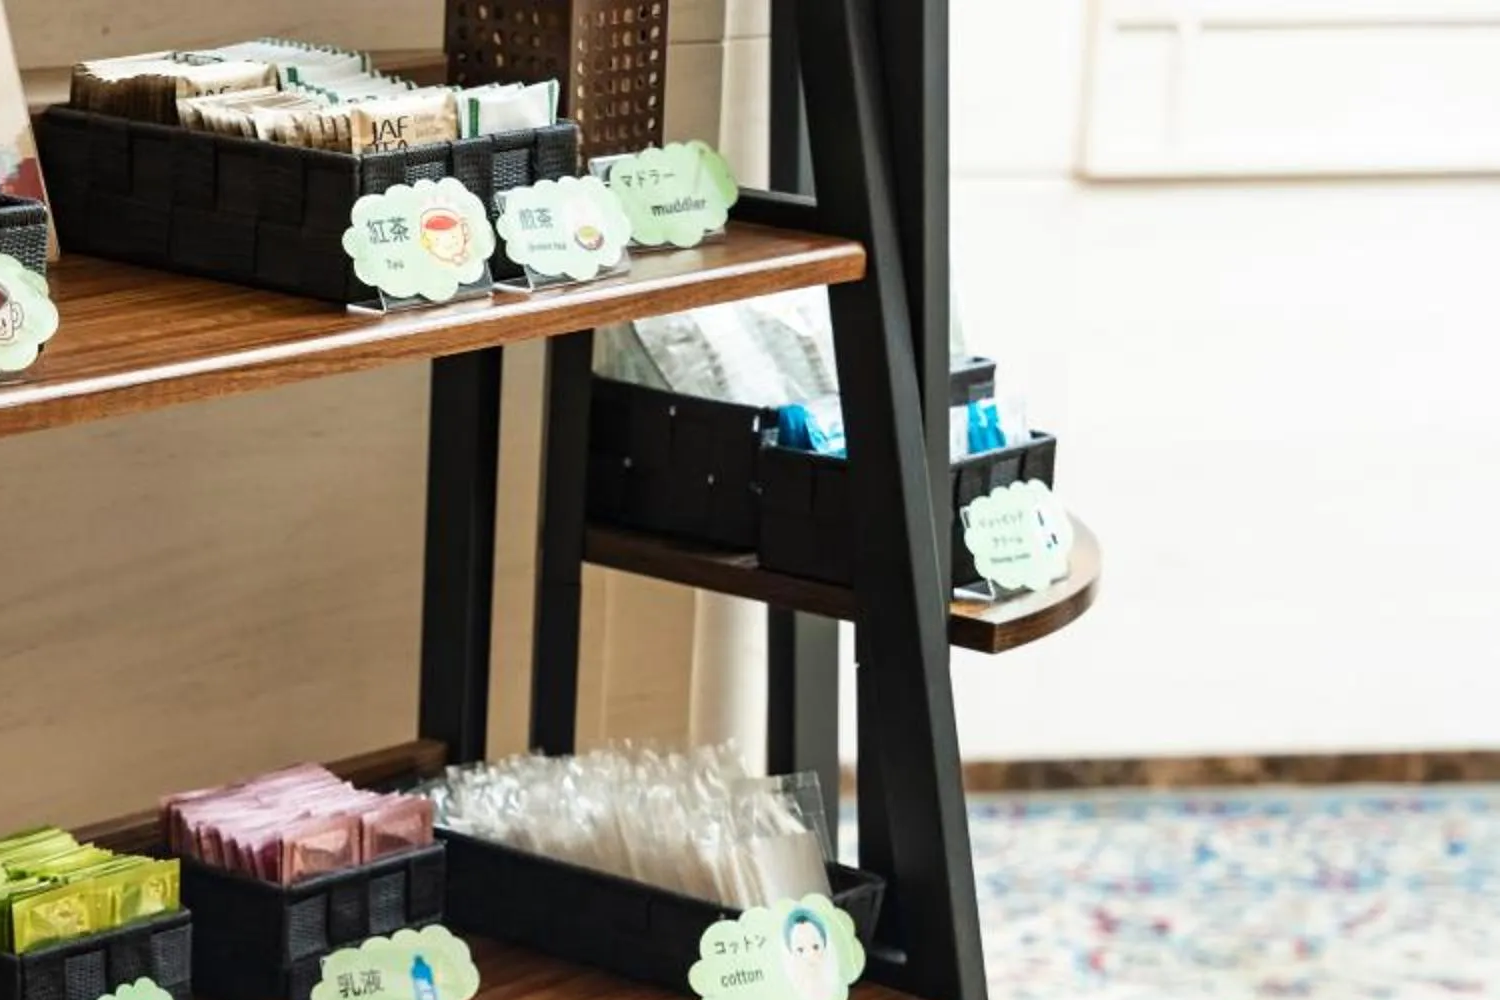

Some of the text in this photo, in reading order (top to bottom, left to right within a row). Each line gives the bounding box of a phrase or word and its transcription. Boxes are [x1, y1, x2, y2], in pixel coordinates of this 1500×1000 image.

[369, 115, 409, 142] JAF
[619, 168, 677, 188] マドラー
[649, 195, 707, 217] muddler
[366, 216, 411, 245] 紅茶
[713, 933, 767, 956] コットン
[336, 968, 385, 999] 乳液
[720, 967, 765, 988] cotton
